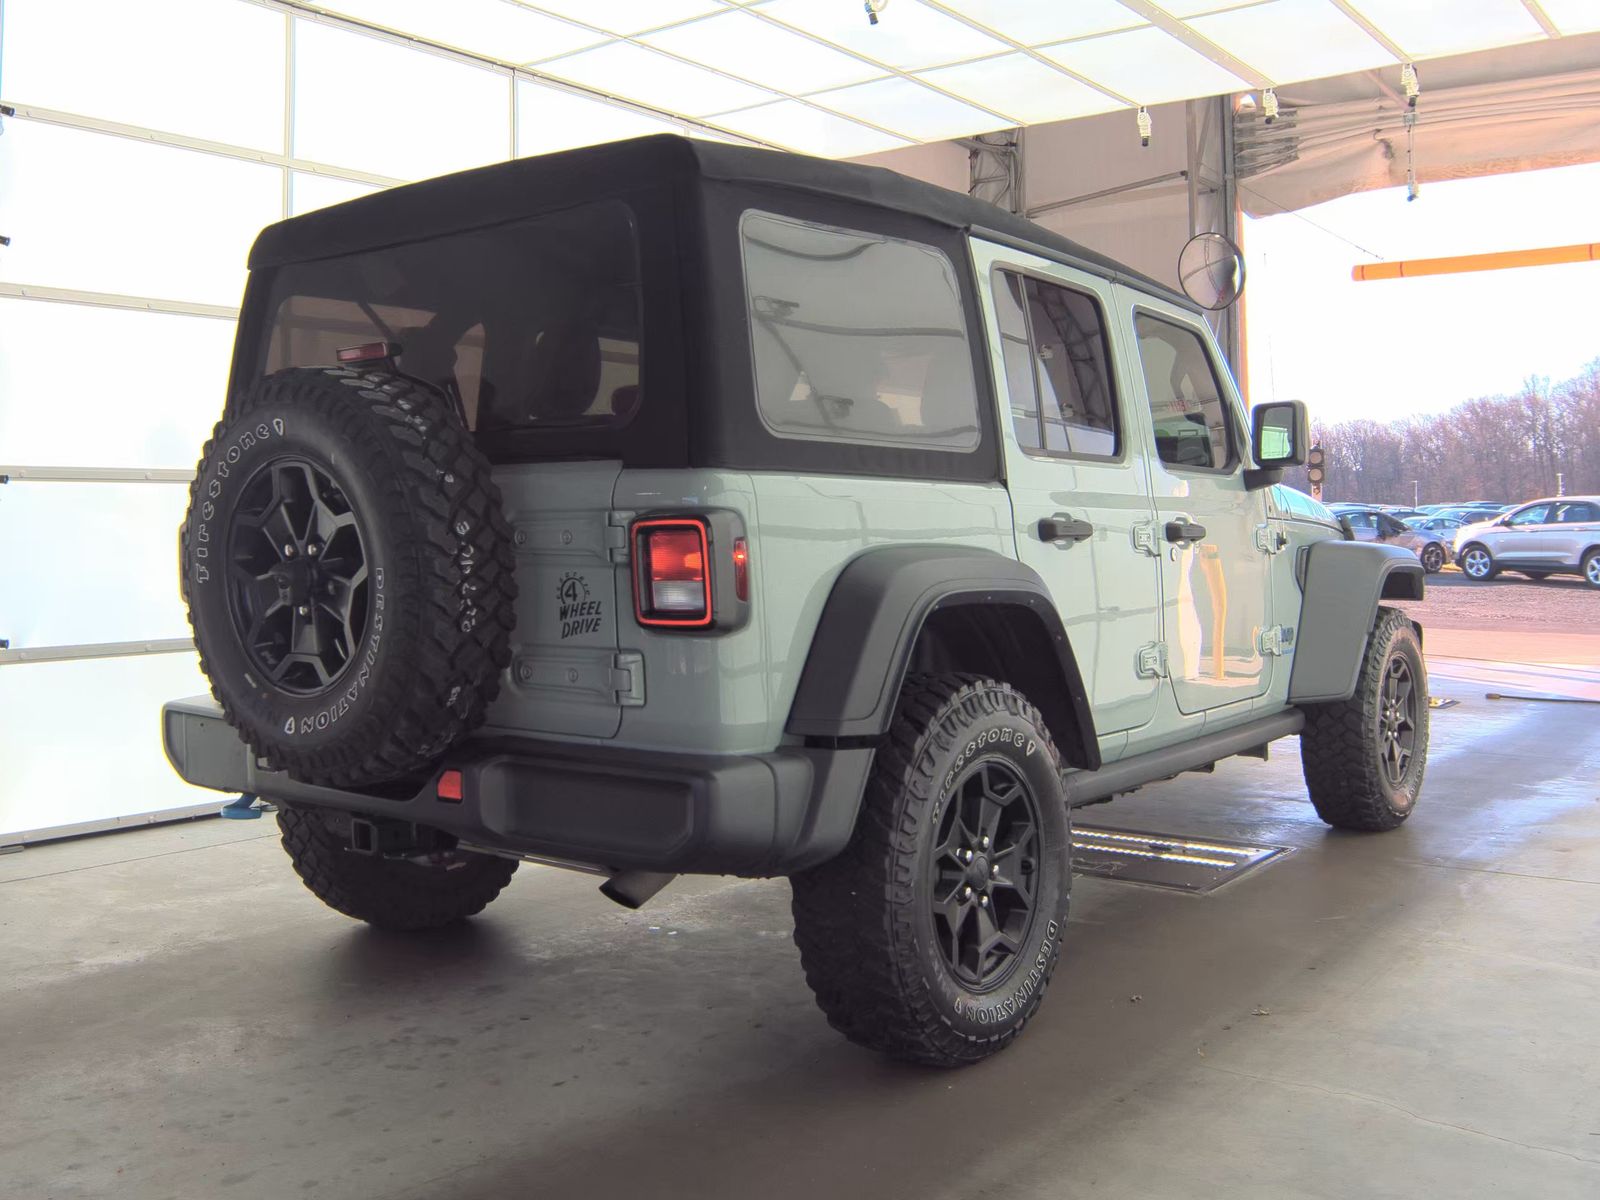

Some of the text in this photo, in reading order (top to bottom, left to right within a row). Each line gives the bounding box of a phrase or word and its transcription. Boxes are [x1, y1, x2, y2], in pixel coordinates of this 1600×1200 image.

[195, 423, 270, 584] Firestone
[559, 600, 602, 621] WHEEL
[561, 617, 602, 640] DRIVE
[564, 580, 578, 602] 4
[300, 567, 385, 735] DESTINATION
[931, 727, 1026, 825] Firestone
[965, 919, 1059, 1025] DESTINATION
